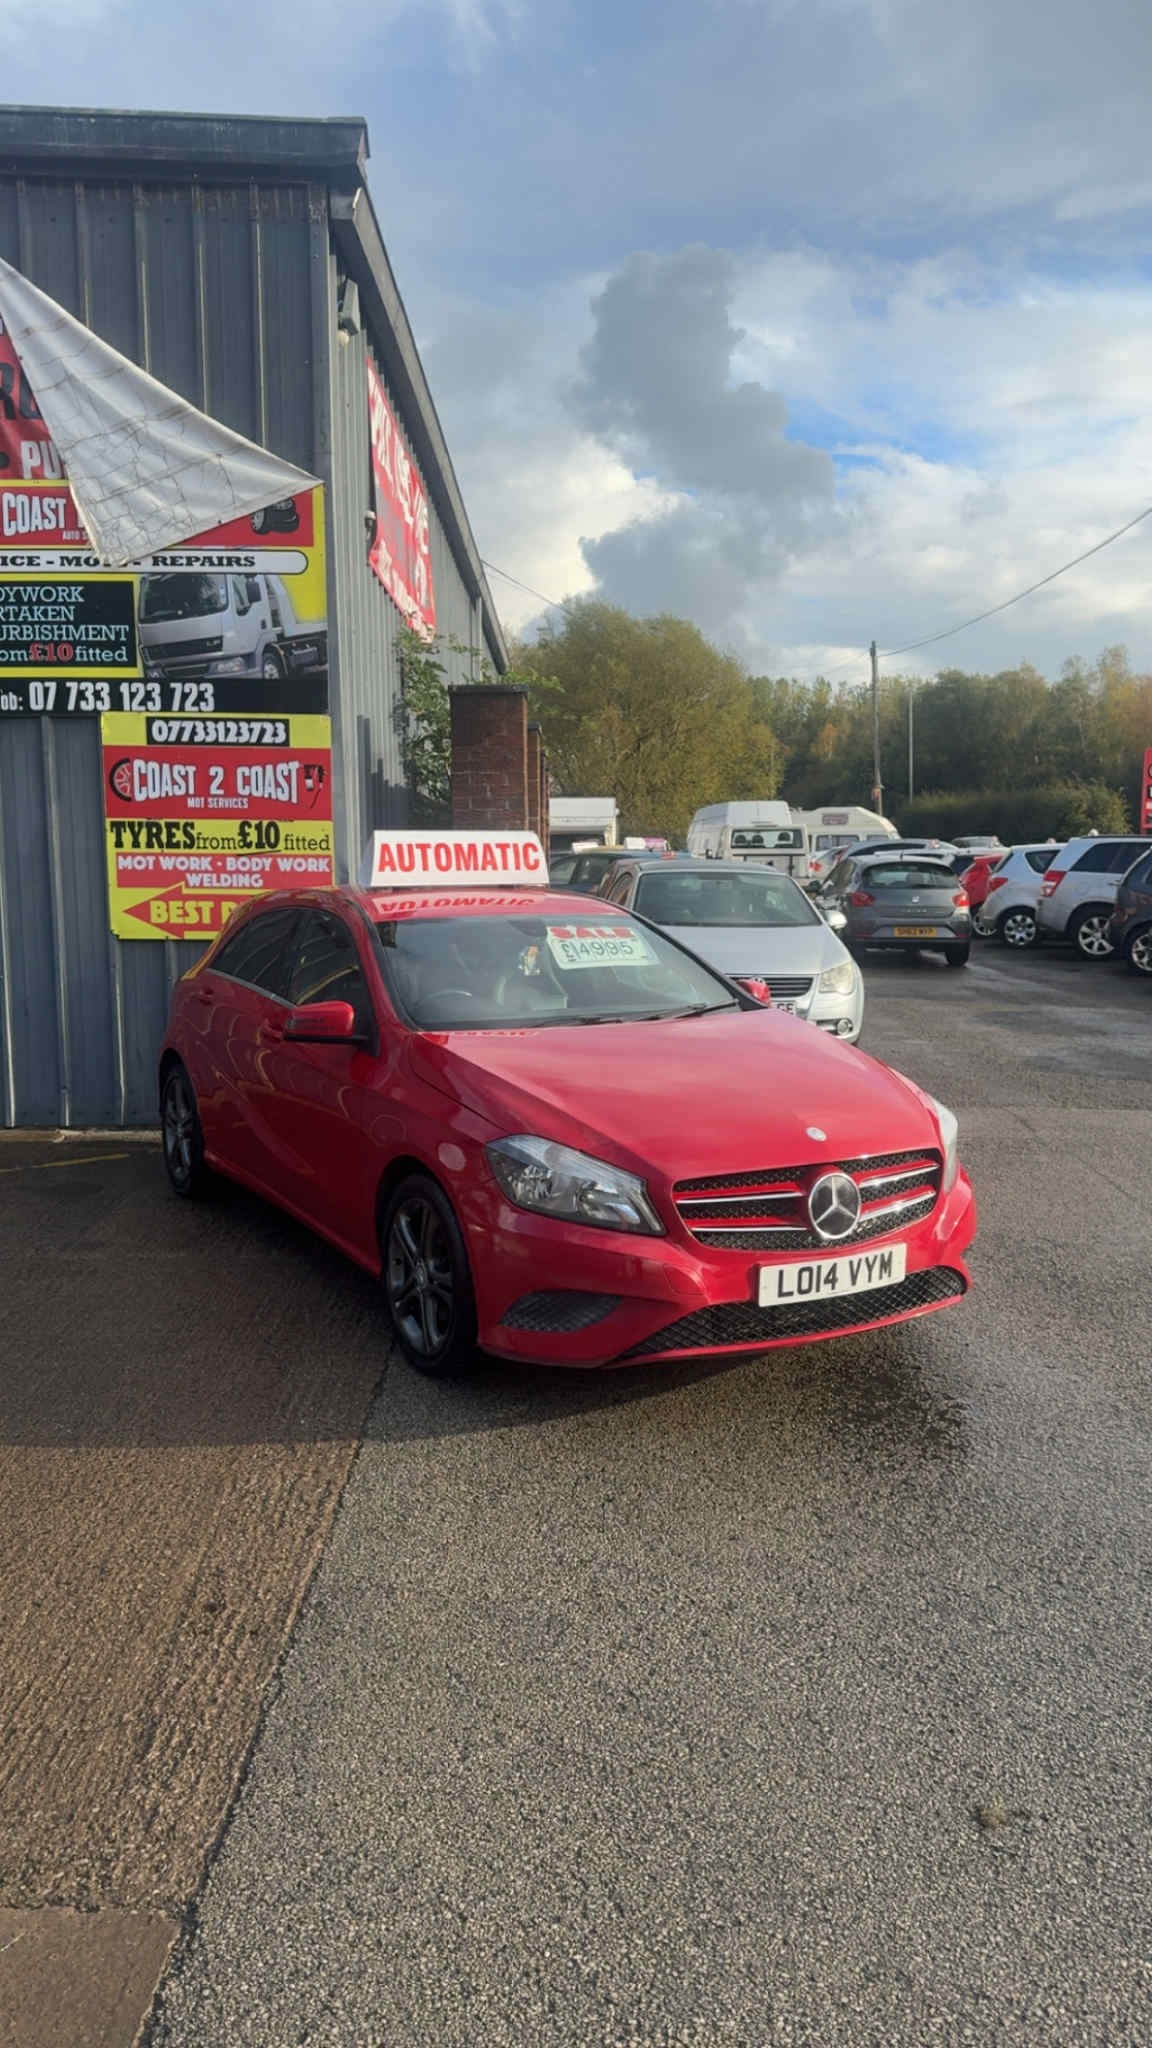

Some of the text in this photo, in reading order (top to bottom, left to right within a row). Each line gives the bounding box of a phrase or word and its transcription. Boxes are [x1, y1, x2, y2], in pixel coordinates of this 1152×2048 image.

[3, 492, 67, 537] COAST
[151, 555, 256, 568] REPAIRS
[29, 642, 74, 662] £10
[75, 645, 128, 662] fitted
[29, 681, 57, 711] 07
[66, 681, 111, 712] 733
[120, 682, 162, 712] 123
[170, 682, 215, 712] 723
[151, 720, 287, 744] 07733123723
[132, 758, 301, 804] COAST 2 COAST
[187, 797, 249, 809] MOT SERVICES
[110, 821, 330, 852] TYRES from £10 fitted
[118, 855, 330, 872] MOT WORK BODY WORK
[378, 842, 540, 873] AUTOMATIC
[186, 873, 263, 888] WELDING
[149, 900, 216, 925] BEST
[550, 926, 636, 940] SALE
[777, 1251, 893, 1298] LO14 VYM
